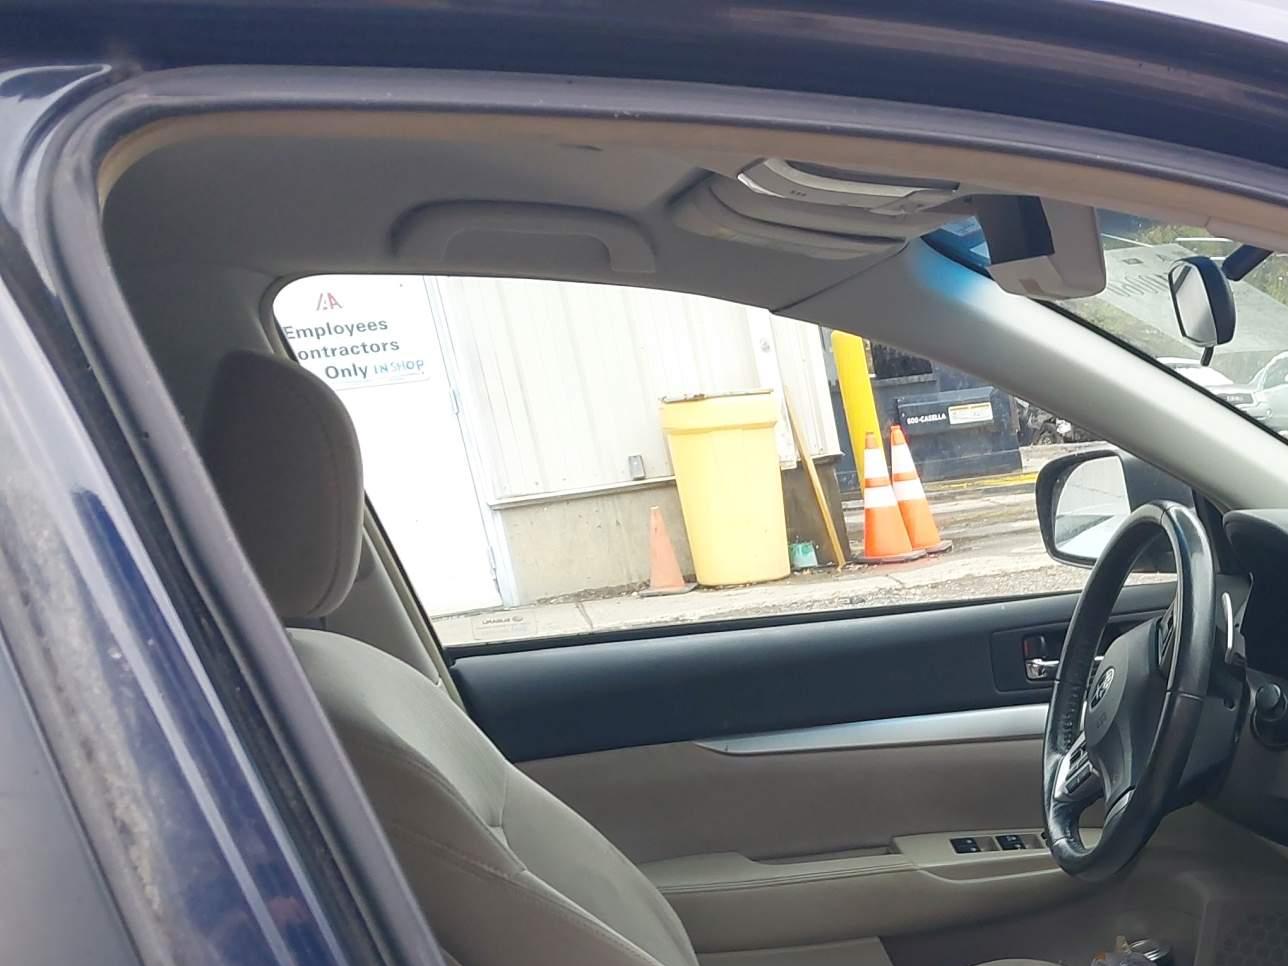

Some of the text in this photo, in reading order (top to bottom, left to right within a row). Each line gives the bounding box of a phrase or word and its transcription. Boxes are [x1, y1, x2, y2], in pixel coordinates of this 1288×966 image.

[284, 318, 388, 340] Employees
[297, 339, 400, 361] ontractors
[325, 363, 368, 380] Only
